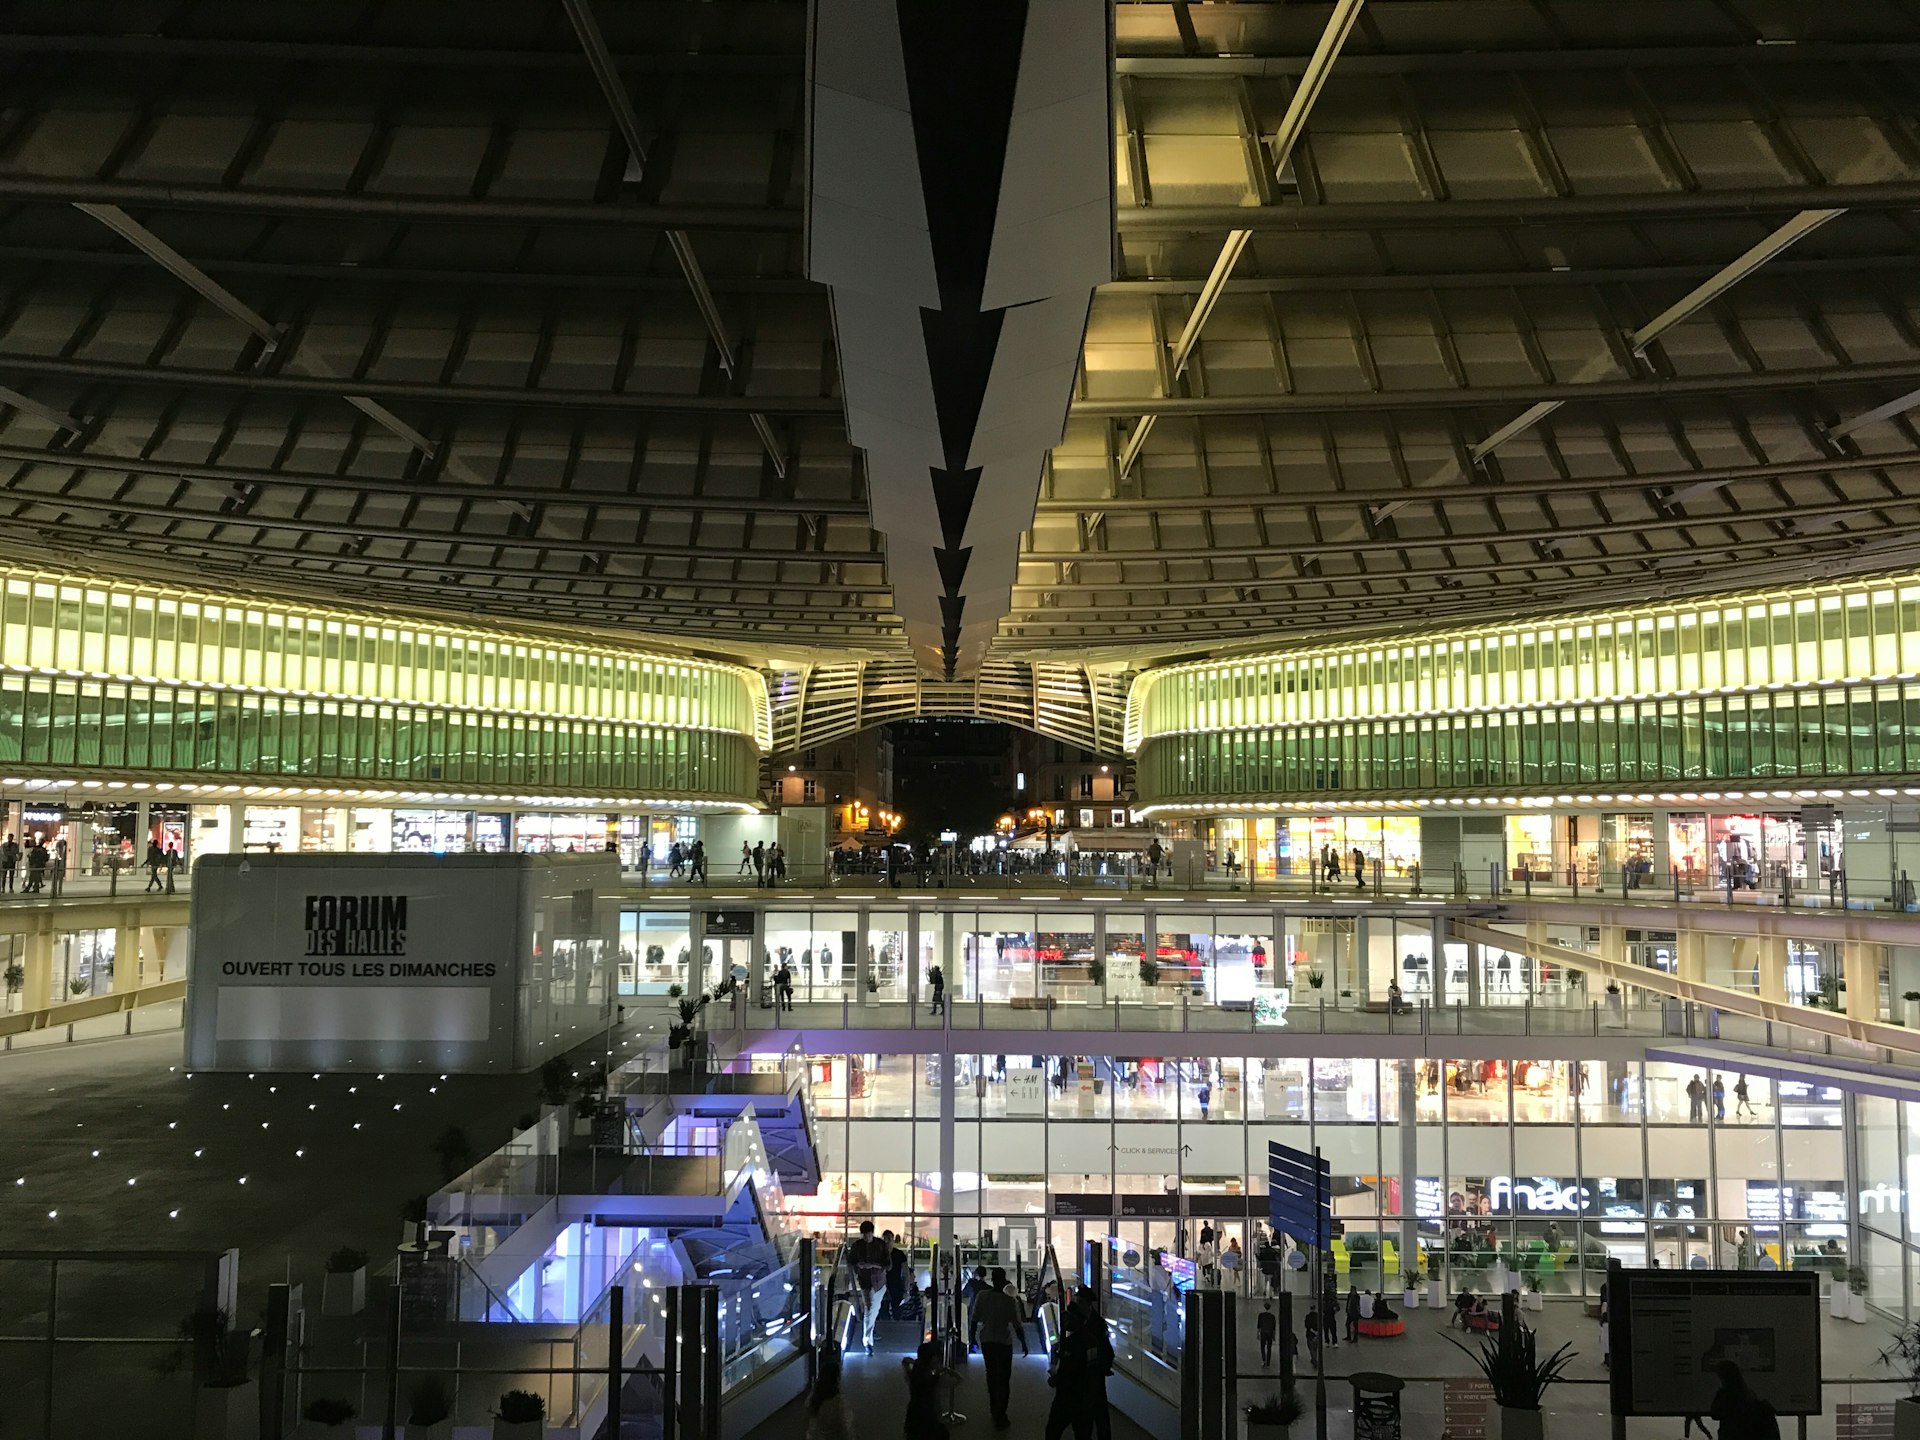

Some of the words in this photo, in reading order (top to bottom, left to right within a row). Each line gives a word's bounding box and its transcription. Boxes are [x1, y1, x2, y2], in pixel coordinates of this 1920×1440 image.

[304, 895, 407, 930] FORUM
[305, 930, 337, 955] DES
[346, 930, 407, 955] HALLES
[222, 961, 293, 976] OUVERT
[298, 962, 345, 976] TOUS
[352, 962, 384, 977] LES
[389, 962, 496, 977] DIMANCHES
[1490, 1176, 1591, 1211] fnac
